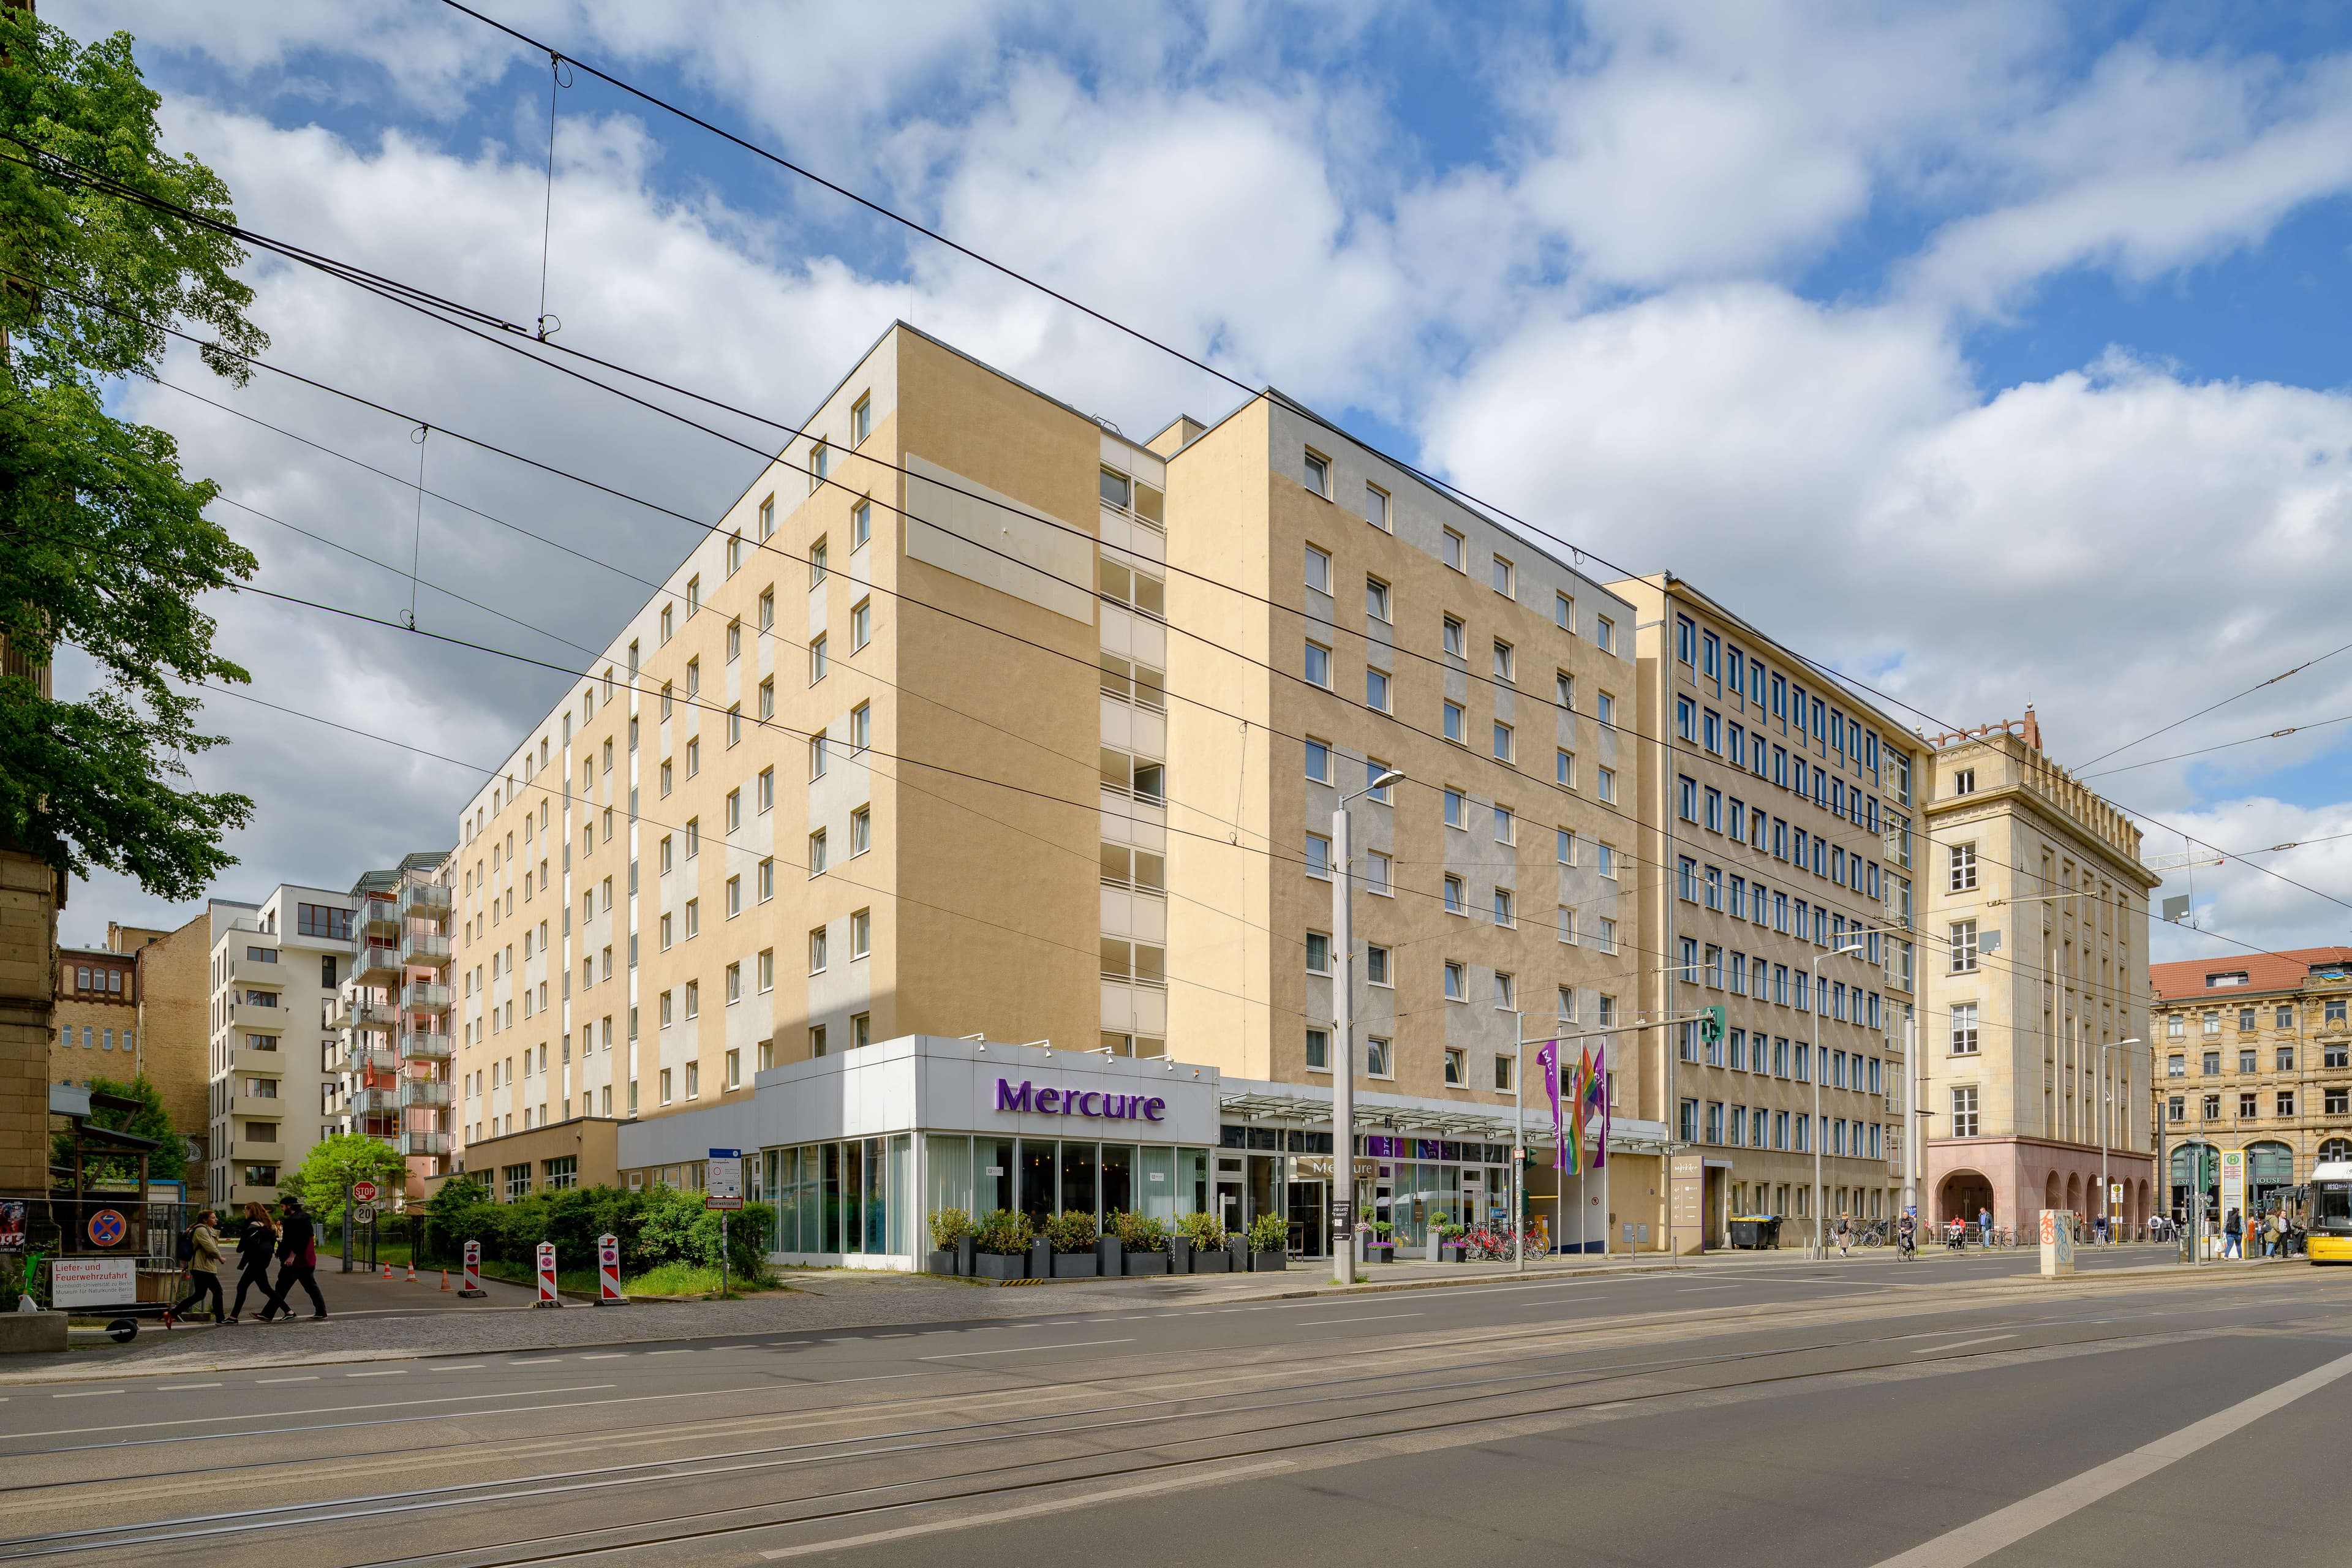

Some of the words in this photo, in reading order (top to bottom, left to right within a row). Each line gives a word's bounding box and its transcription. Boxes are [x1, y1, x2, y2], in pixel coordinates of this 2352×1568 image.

[995, 1078, 1166, 1121] Mercure
[1313, 1163, 1372, 1174] Meure
[355, 1187, 374, 1196] STOP
[359, 1208, 371, 1219] 20
[56, 1272, 127, 1281] Feuerwehrzufahrt
